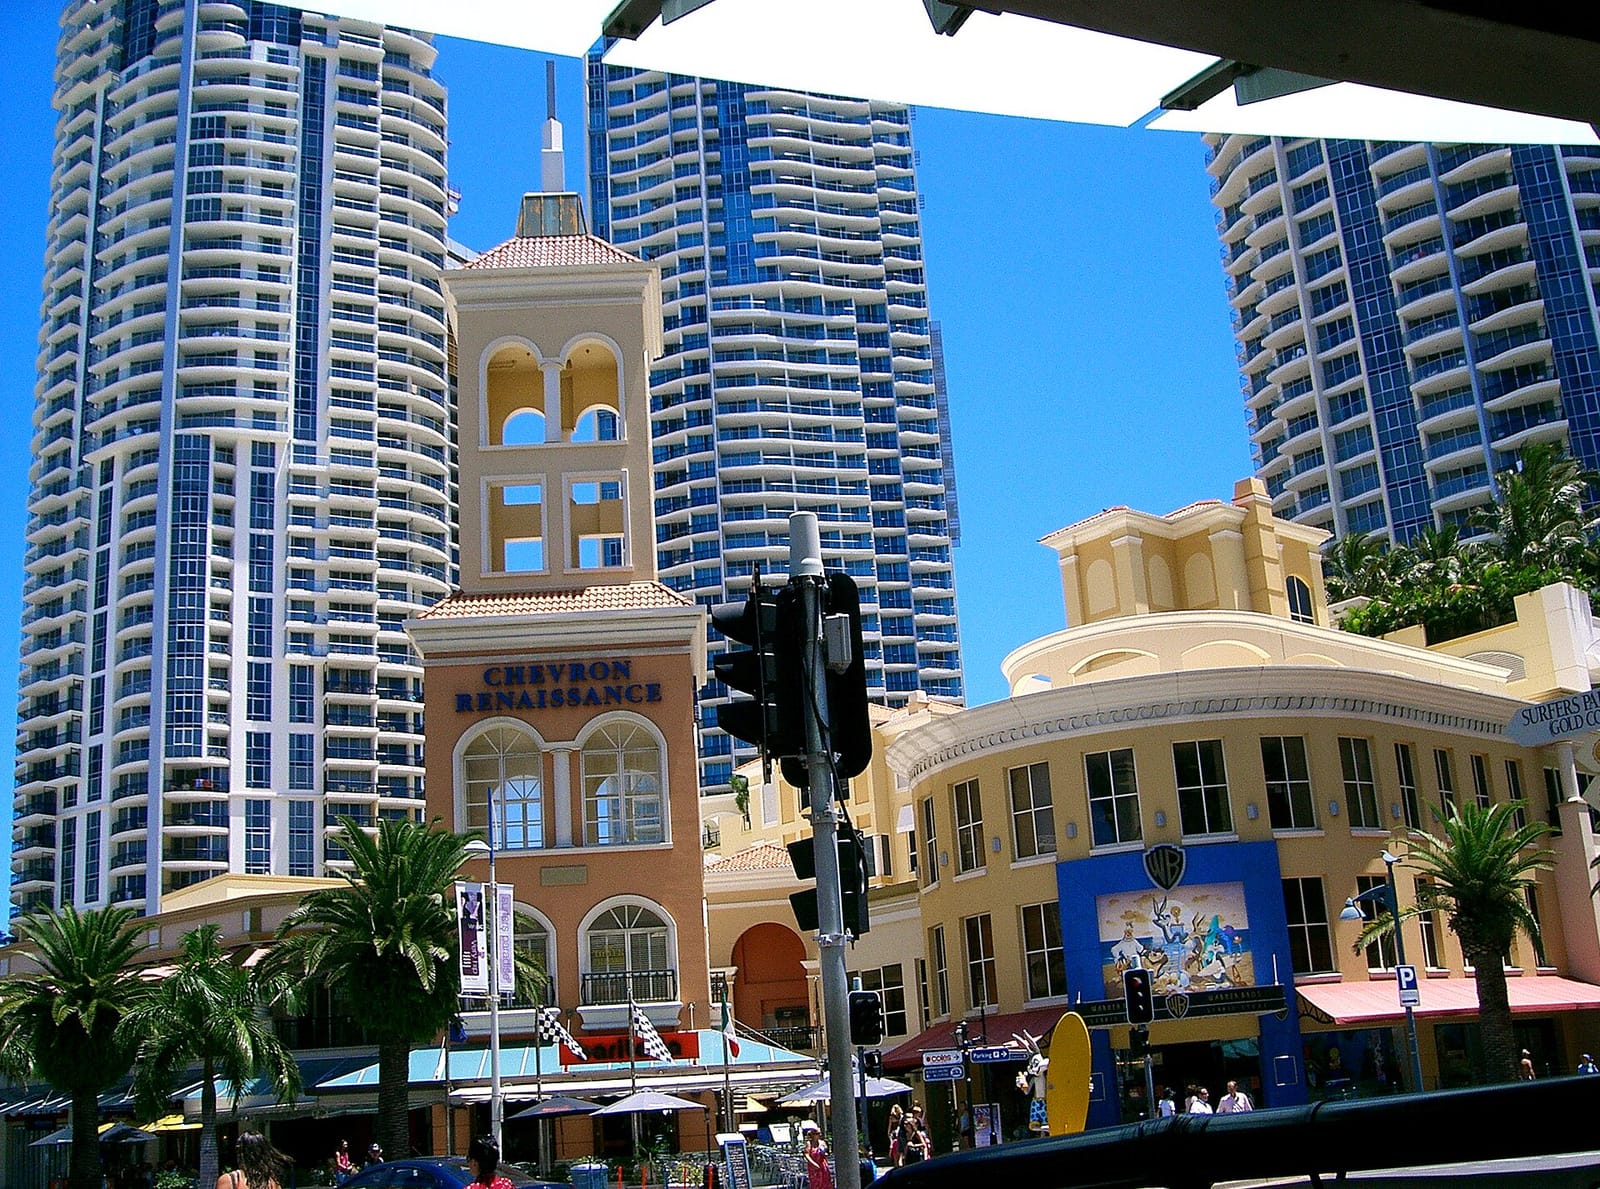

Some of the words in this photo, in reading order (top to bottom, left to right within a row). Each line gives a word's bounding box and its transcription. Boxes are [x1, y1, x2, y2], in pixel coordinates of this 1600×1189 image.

[483, 660, 631, 686] CHEVRON
[455, 683, 662, 713] RENAISSANCE
[1521, 696, 1580, 726] SURFERS
[1549, 714, 1584, 737] GOLD
[1148, 849, 1180, 887] WB
[501, 896, 511, 932] surfers
[1400, 968, 1414, 989] P
[1168, 996, 1186, 1018] WB
[973, 1051, 993, 1060] Parking
